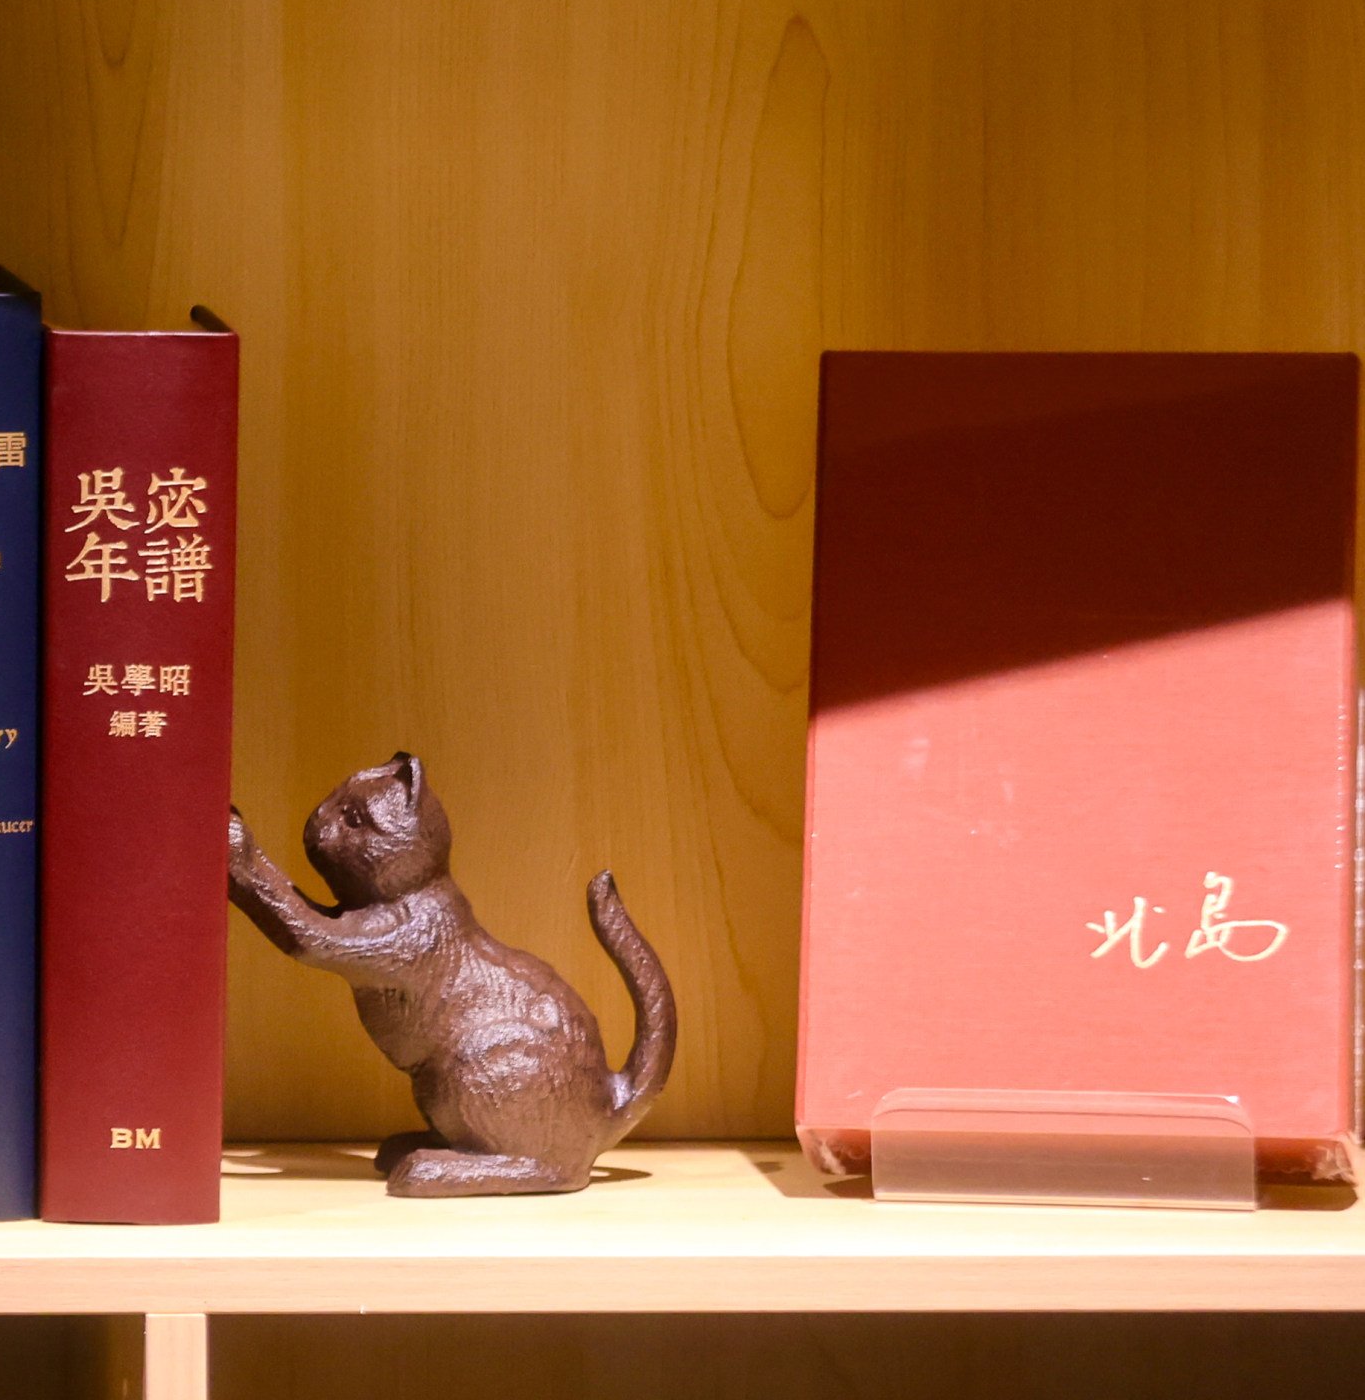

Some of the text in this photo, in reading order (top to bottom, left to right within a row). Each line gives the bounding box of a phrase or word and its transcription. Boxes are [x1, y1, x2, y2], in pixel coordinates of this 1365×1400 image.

[65, 468, 207, 533] 吳宓
[66, 532, 213, 602] 年譜
[83, 665, 191, 697] 吳學昭
[109, 711, 167, 738] 編著
[1088, 872, 1288, 968] 北島
[110, 1128, 161, 1149] BM
